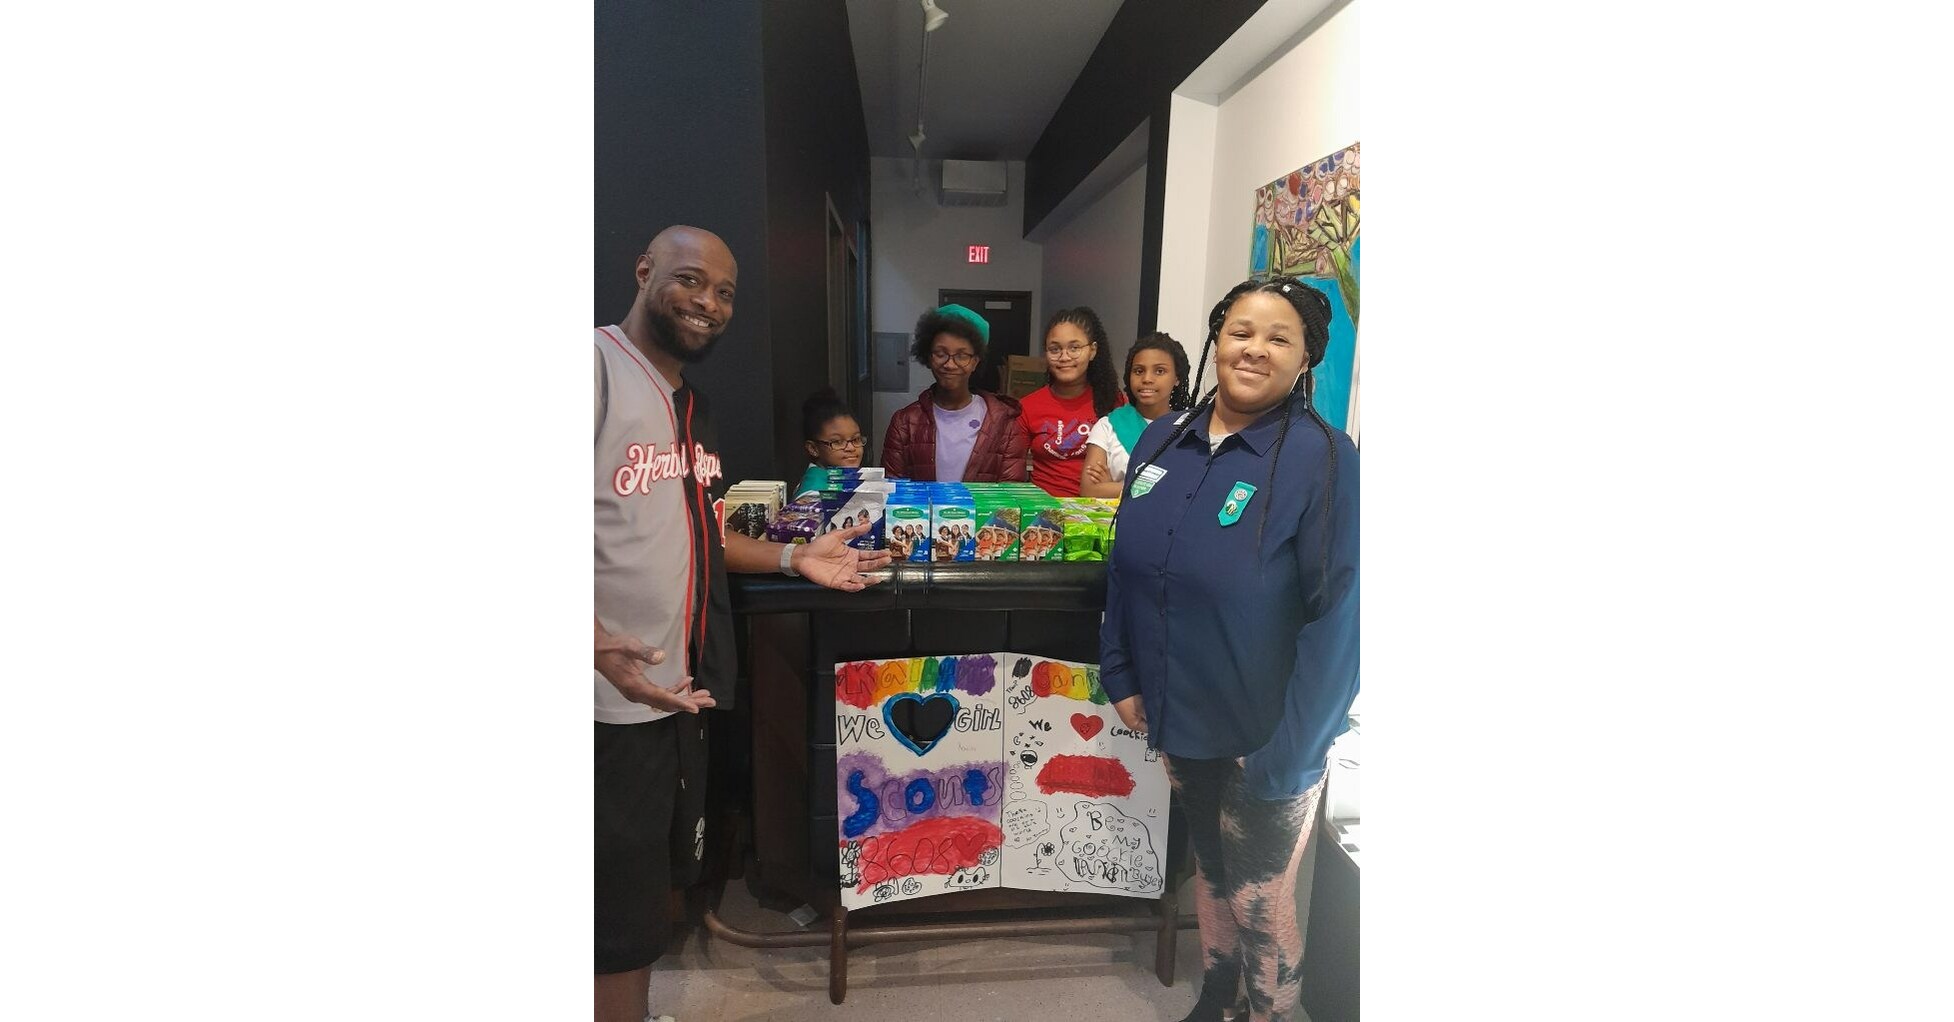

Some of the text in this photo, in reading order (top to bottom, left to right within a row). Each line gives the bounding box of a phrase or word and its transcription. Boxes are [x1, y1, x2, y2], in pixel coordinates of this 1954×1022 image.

[968, 245, 990, 264] EXIT
[1008, 685, 1036, 710] 8608
[838, 714, 886, 745] We
[1029, 718, 1052, 733] We
[1086, 810, 1115, 832] Be
[861, 836, 954, 885] 8608
